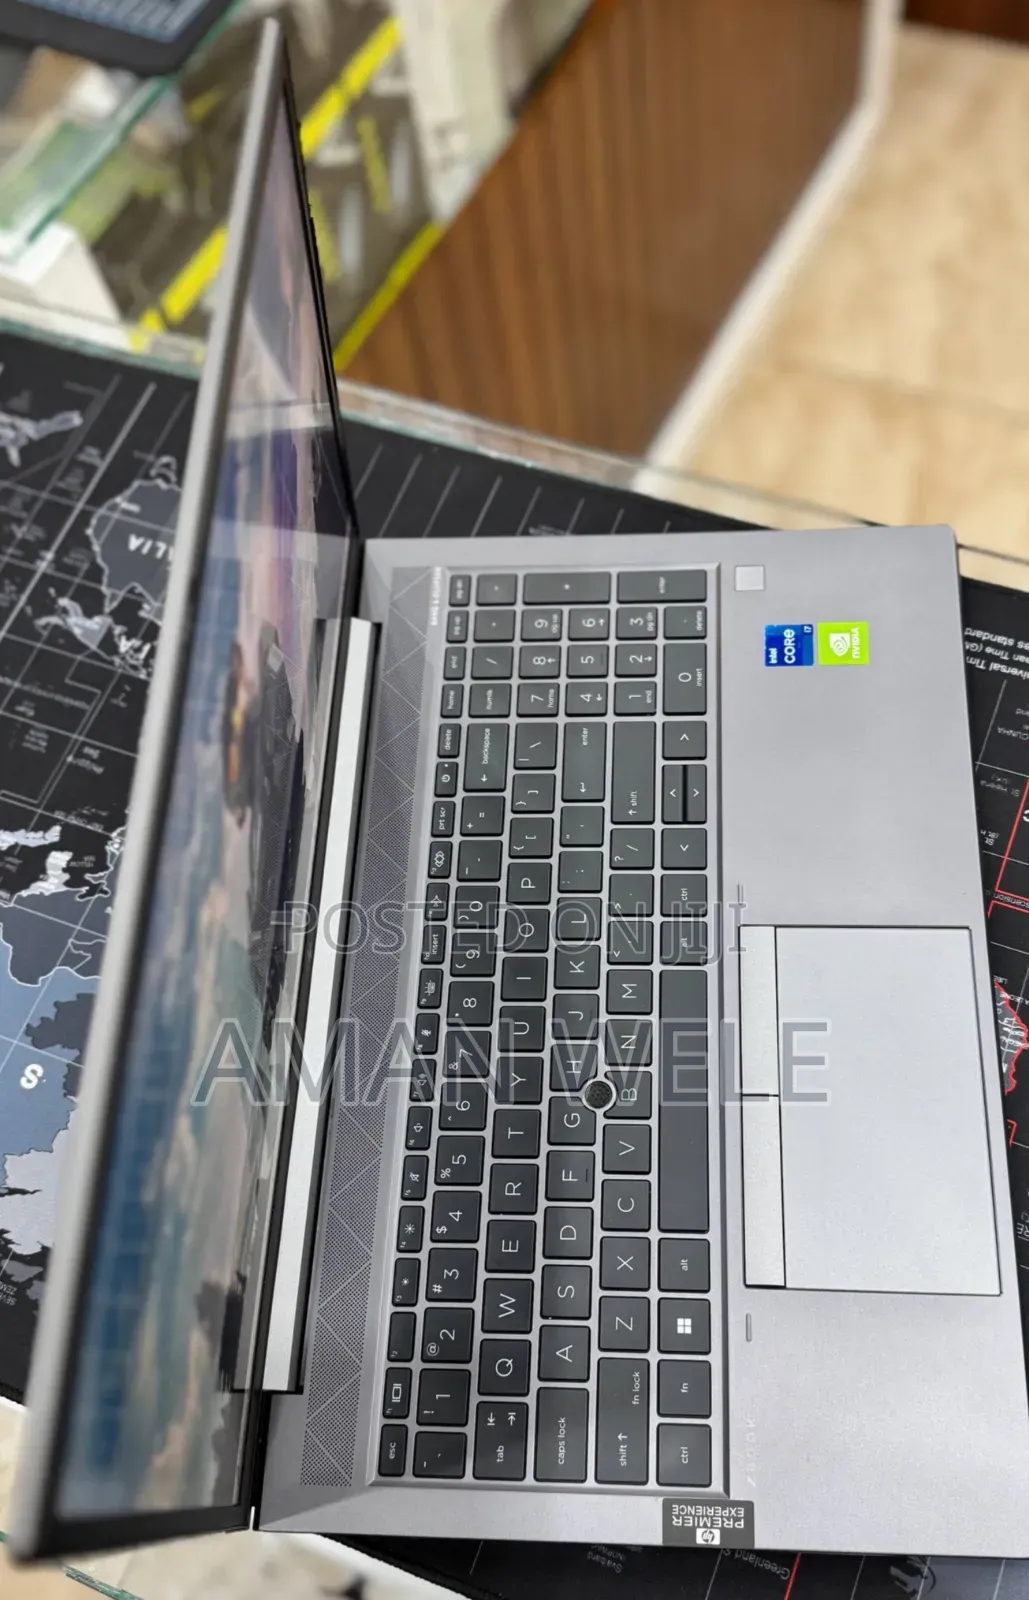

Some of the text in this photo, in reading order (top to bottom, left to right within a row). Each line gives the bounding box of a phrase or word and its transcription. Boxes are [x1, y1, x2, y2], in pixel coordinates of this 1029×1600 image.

[534, 618, 548, 629] 9
[582, 618, 596, 628] 6
[630, 616, 644, 626] 3
[580, 655, 594, 664] 5
[629, 654, 642, 664] 2
[984, 646, 1009, 660] Time
[532, 656, 546, 666] 8
[530, 694, 544, 703] 7
[580, 693, 592, 702] 4
[444, 729, 452, 751] delete
[481, 728, 491, 764] backspace
[520, 877, 536, 889] P
[680, 888, 688, 900] ctrl
[469, 900, 483, 912] 0
[570, 914, 587, 924] L
[518, 922, 535, 938] O
[680, 937, 688, 948] alt
[466, 950, 480, 960] 9
[569, 960, 585, 973] K
[622, 984, 638, 998] M
[462, 998, 477, 1008] 8
[568, 1010, 584, 1021] J
[513, 1021, 530, 1035] U
[620, 1034, 636, 1049] N
[459, 1049, 473, 1058] 7
[448, 1061, 458, 1070] &
[566, 1060, 582, 1074] H
[510, 1072, 526, 1087] Y
[620, 1088, 638, 1101] B
[456, 1100, 470, 1111] 6
[564, 1112, 581, 1128] G
[508, 1126, 524, 1140] T
[619, 1140, 636, 1156] V
[452, 1154, 467, 1165] 5
[440, 1168, 452, 1179] %
[562, 1169, 578, 1182] F
[504, 1182, 522, 1196] R
[617, 1197, 635, 1213] C
[448, 1210, 463, 1222] 4
[435, 1225, 448, 1234] $
[559, 1224, 576, 1240] D
[502, 1240, 519, 1253] E
[616, 1256, 634, 1271] X
[680, 1258, 688, 1271] alt
[444, 1268, 460, 1280] 3
[432, 1284, 442, 1294] #
[557, 1285, 575, 1299] S
[498, 1292, 516, 1318] W
[615, 1316, 633, 1331] Z
[439, 1329, 456, 1341] 2
[426, 1342, 440, 1356] @
[555, 1344, 573, 1363] A
[495, 1358, 514, 1377] Q
[632, 1371, 640, 1405] fn lock
[680, 1382, 688, 1393] fn
[558, 1416, 566, 1465] caps lock
[388, 1442, 396, 1460] esc
[496, 1444, 504, 1463] tab
[618, 1444, 628, 1466] shift
[680, 1446, 688, 1464] ctrl
[672, 1504, 744, 1517] EXPERIENCE
[672, 1516, 744, 1529] PREMIER
